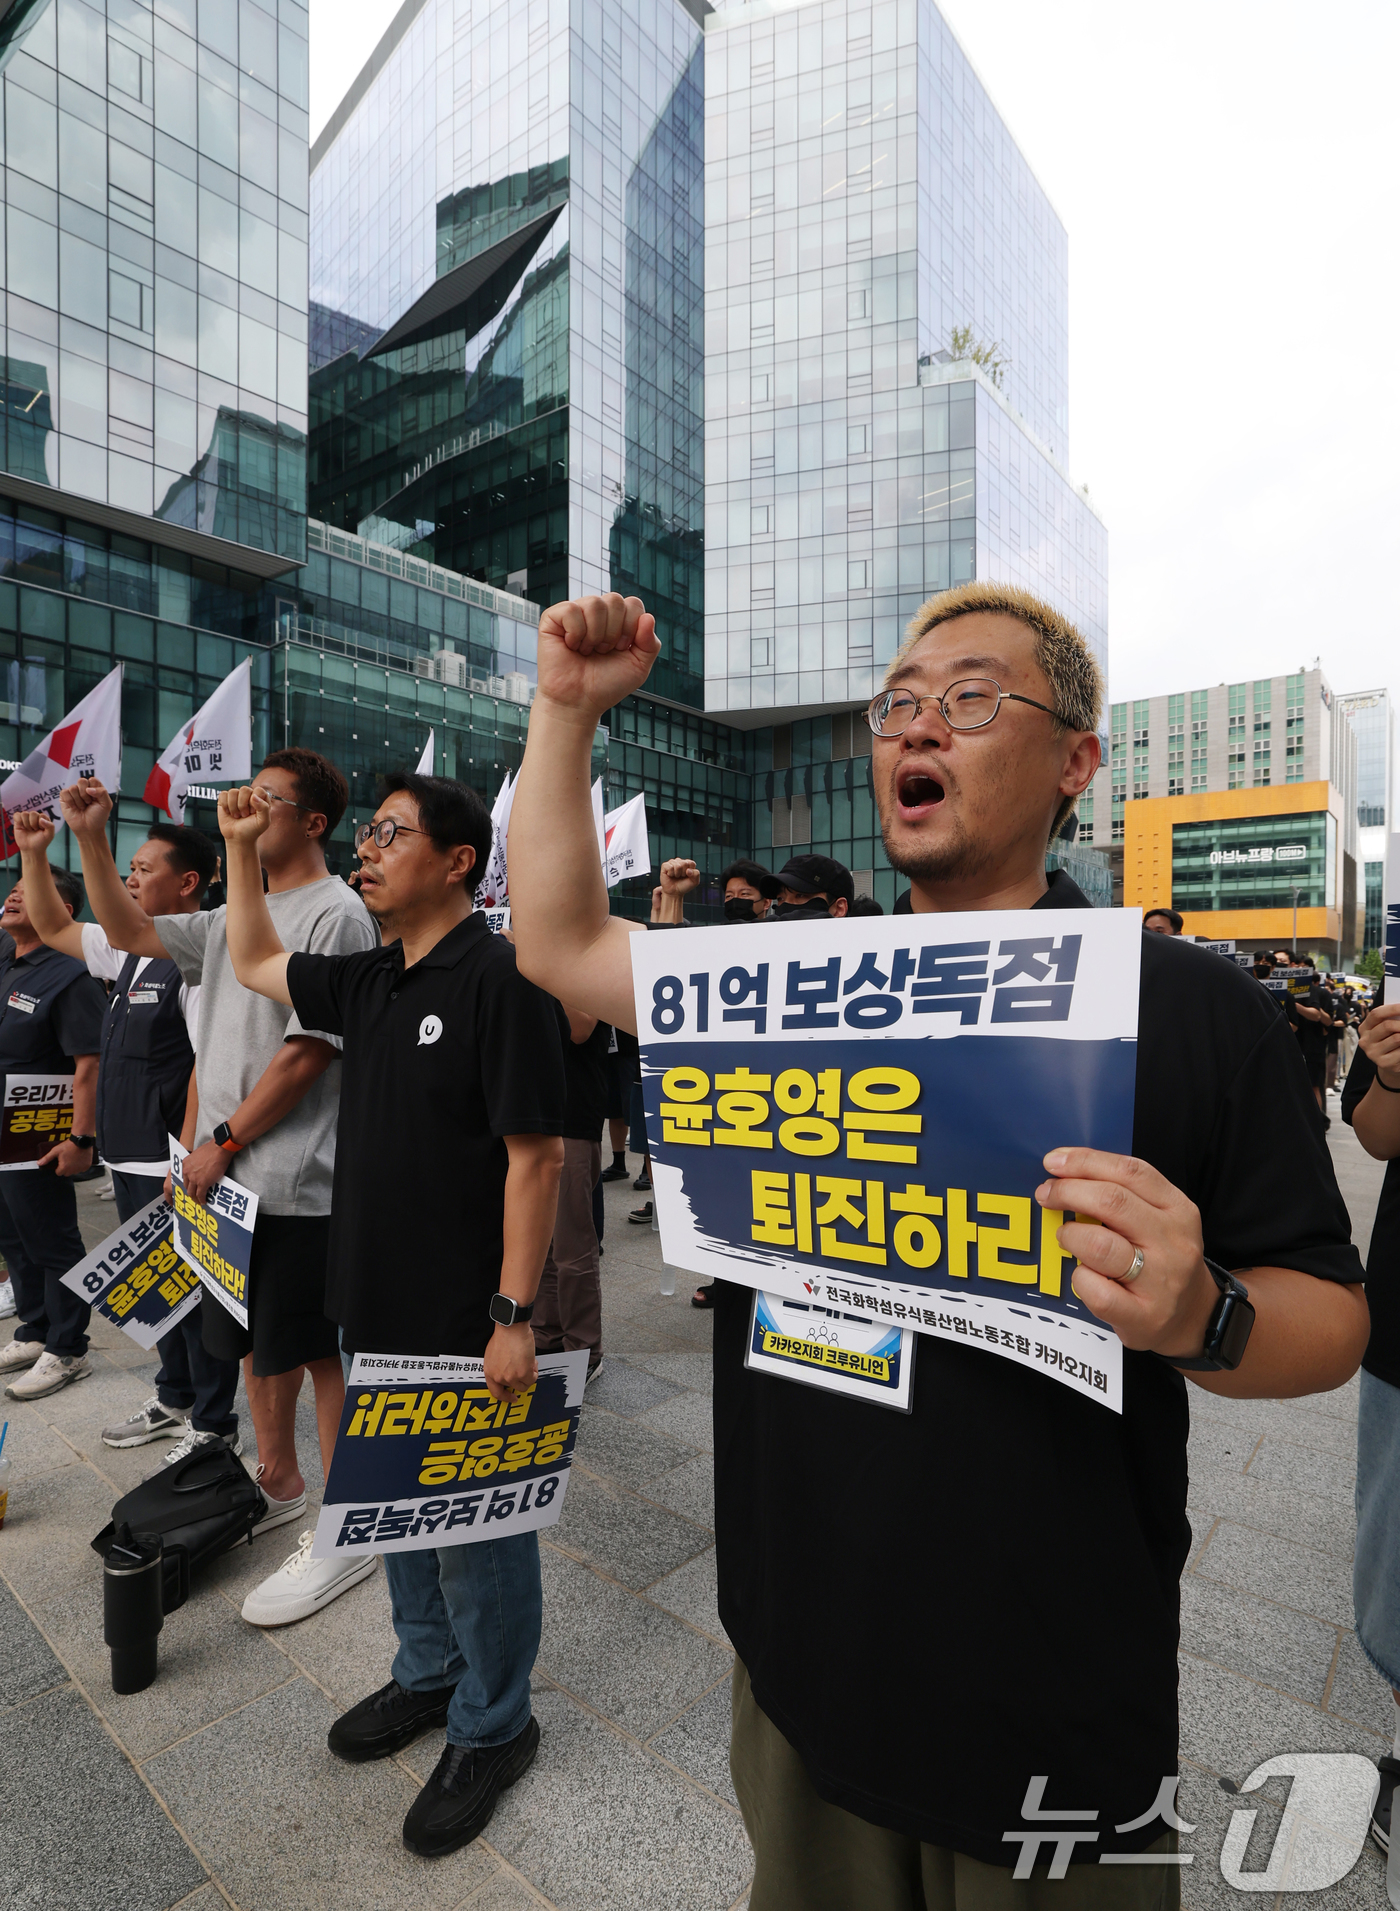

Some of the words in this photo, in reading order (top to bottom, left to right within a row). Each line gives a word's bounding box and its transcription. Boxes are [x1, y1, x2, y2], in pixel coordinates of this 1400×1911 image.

[1340, 698, 1379, 711] YARD
[1210, 847, 1274, 864] 아브뉴프랑
[485, 912, 505, 931] 독점
[651, 962, 770, 1035] 81억
[781, 934, 1083, 1030] 보상독점
[8, 1084, 67, 1104] 우리가
[659, 1066, 923, 1165] 윤호영은
[174, 1185, 219, 1248] 윤호영은
[750, 1169, 1102, 1299] 퇴진하라
[82, 1240, 135, 1294] 81억
[128, 1200, 174, 1249] 보상
[106, 1231, 178, 1318] 윤호영
[191, 1229, 246, 1301] 퇴진하라!
[359, 1357, 400, 1370] 카카오지회
[770, 1336, 823, 1361] 카카오지회
[826, 1349, 884, 1376] 크루유니언
[826, 1285, 1031, 1356] 전국화학섬유식품산업노동조합
[1035, 1341, 1108, 1393] 카카오지회
[346, 1382, 537, 1437] 퇴진하라!
[418, 1419, 571, 1486] 윤호영은
[335, 1493, 485, 1547] 보상독점
[482, 1476, 560, 1524] 81억
